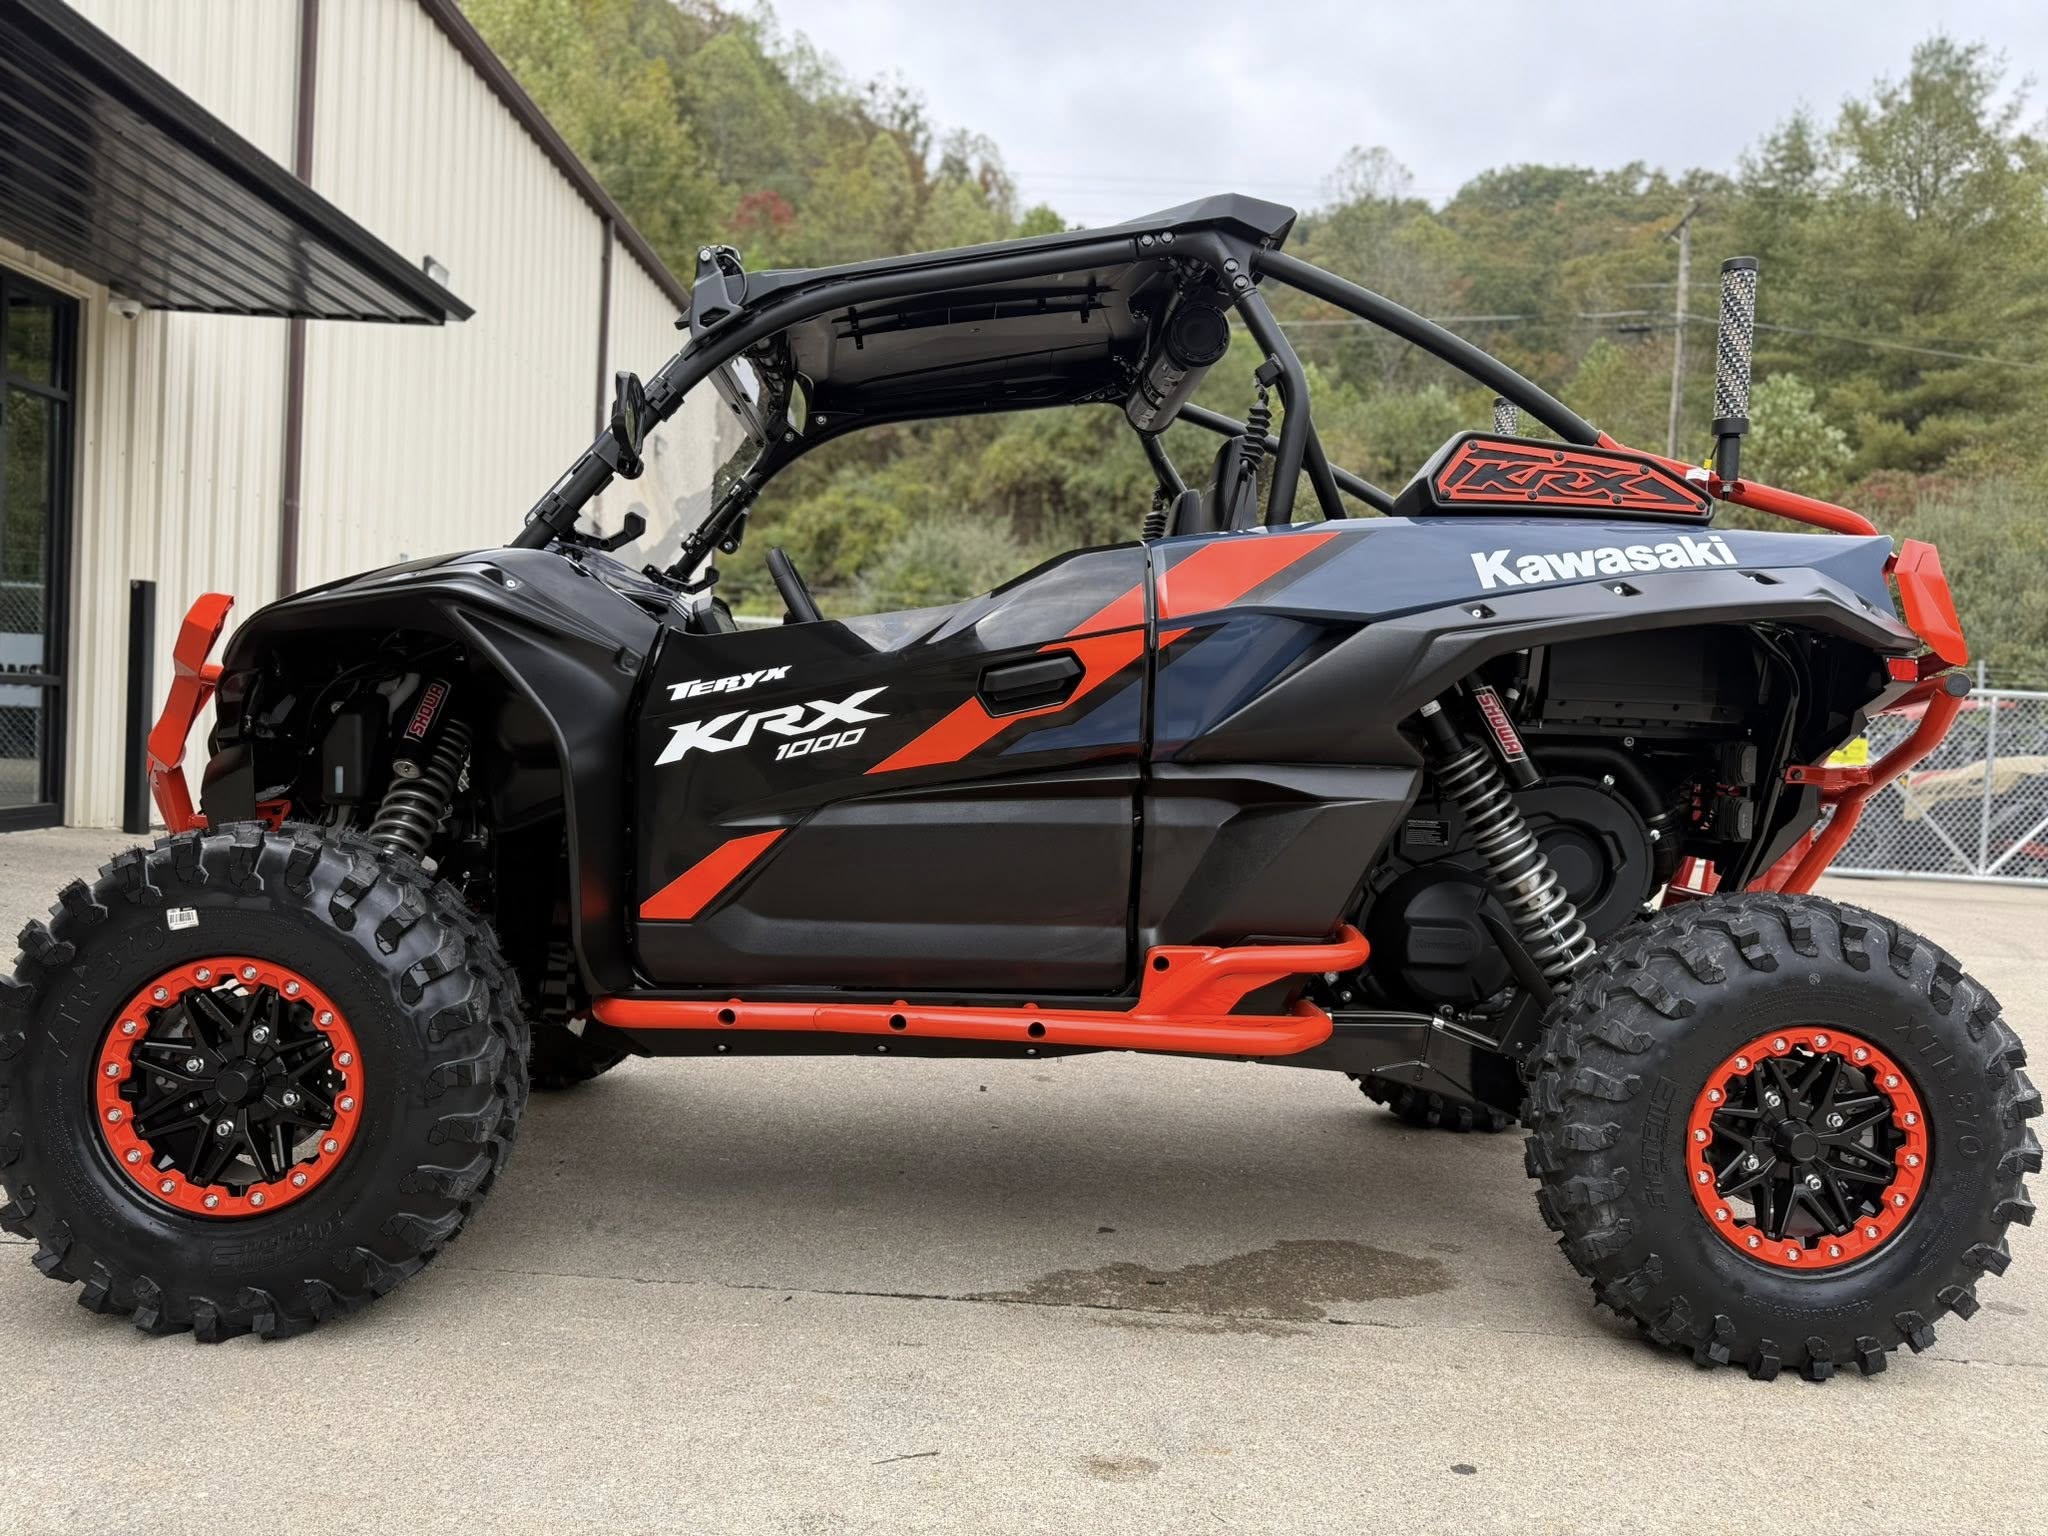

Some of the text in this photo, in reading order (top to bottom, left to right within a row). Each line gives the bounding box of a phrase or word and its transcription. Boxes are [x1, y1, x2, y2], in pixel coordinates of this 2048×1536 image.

[1457, 458, 1666, 500] KRX
[1470, 535, 1739, 589] Kawasaki
[409, 683, 446, 738] SHOWA
[654, 686, 891, 766] KRX
[1475, 693, 1523, 754] SHOWA
[775, 727, 867, 761] 1000
